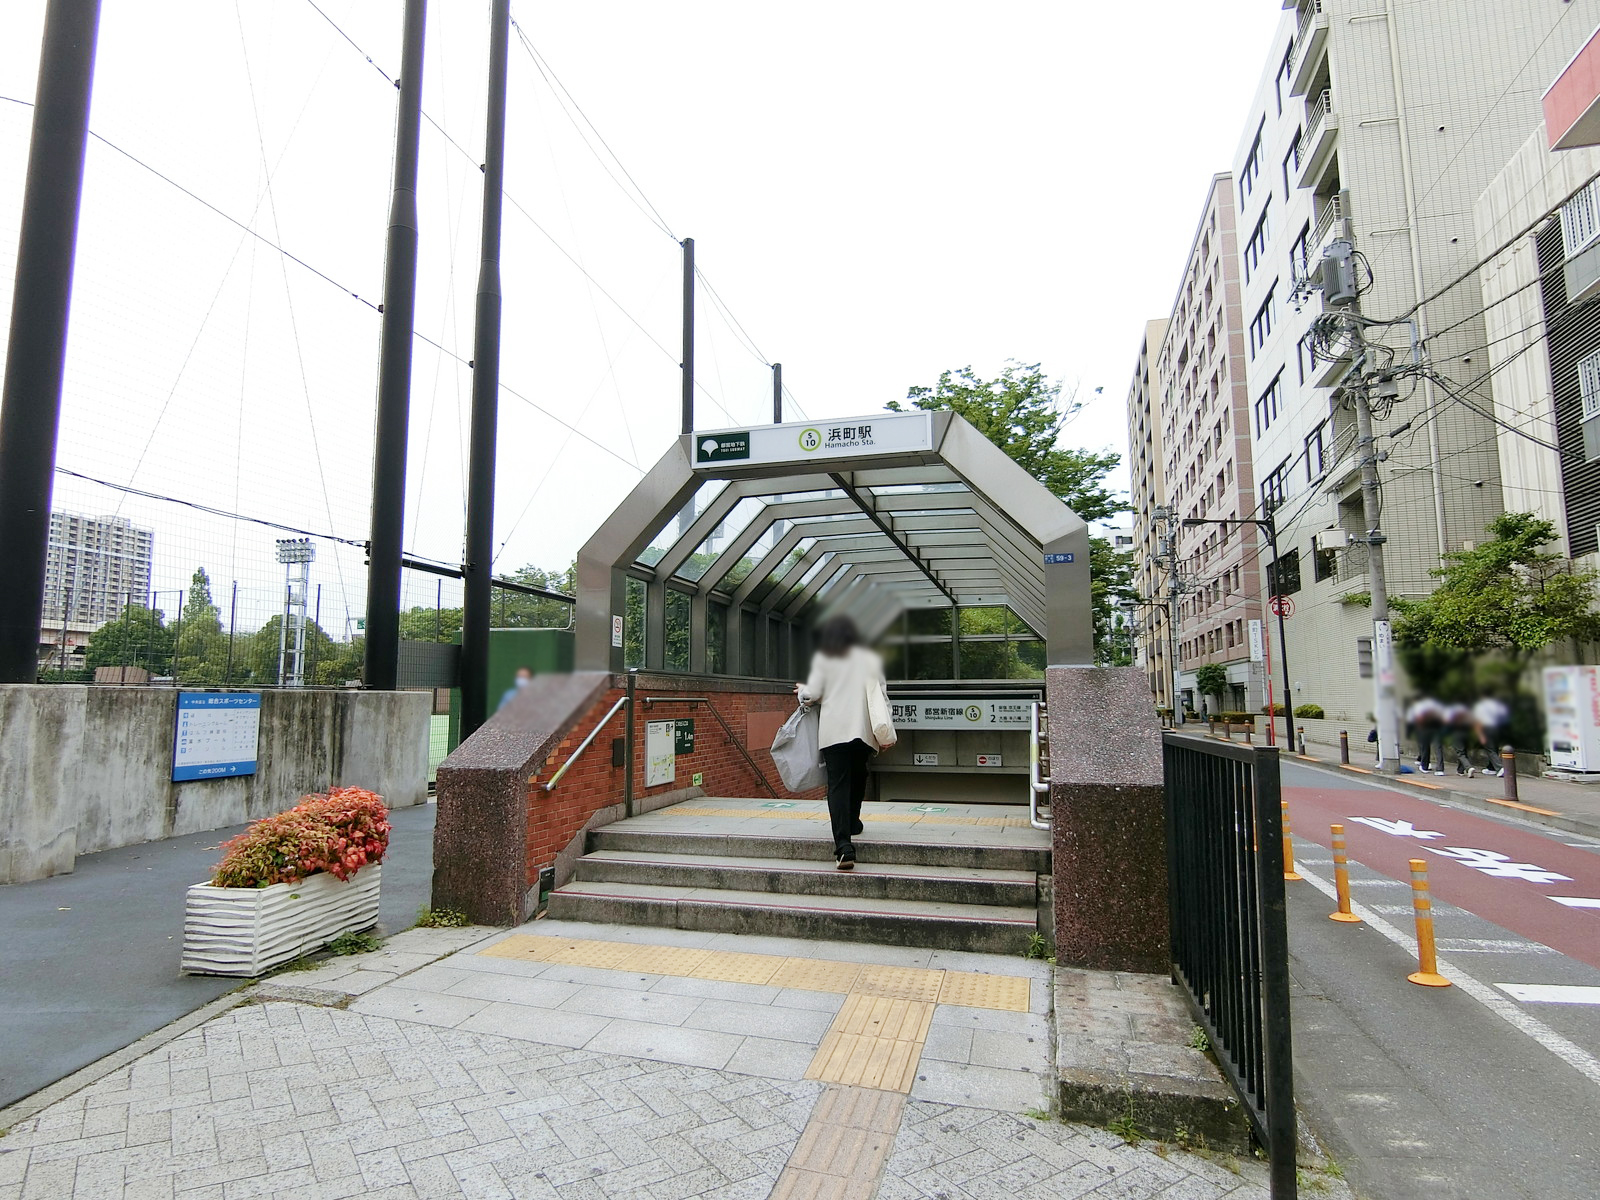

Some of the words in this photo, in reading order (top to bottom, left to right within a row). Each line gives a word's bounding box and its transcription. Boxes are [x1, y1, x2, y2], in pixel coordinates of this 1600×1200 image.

[828, 425, 873, 442] 浜町駅
[805, 438, 816, 447] 10
[824, 440, 860, 449] Hamacho
[862, 438, 876, 446] Sta.
[208, 697, 257, 705] 総合スポーツセンター
[892, 704, 917, 717] 町駅
[924, 707, 963, 715] 都営新宿線
[990, 704, 995, 713] 1
[990, 715, 996, 723] 2
